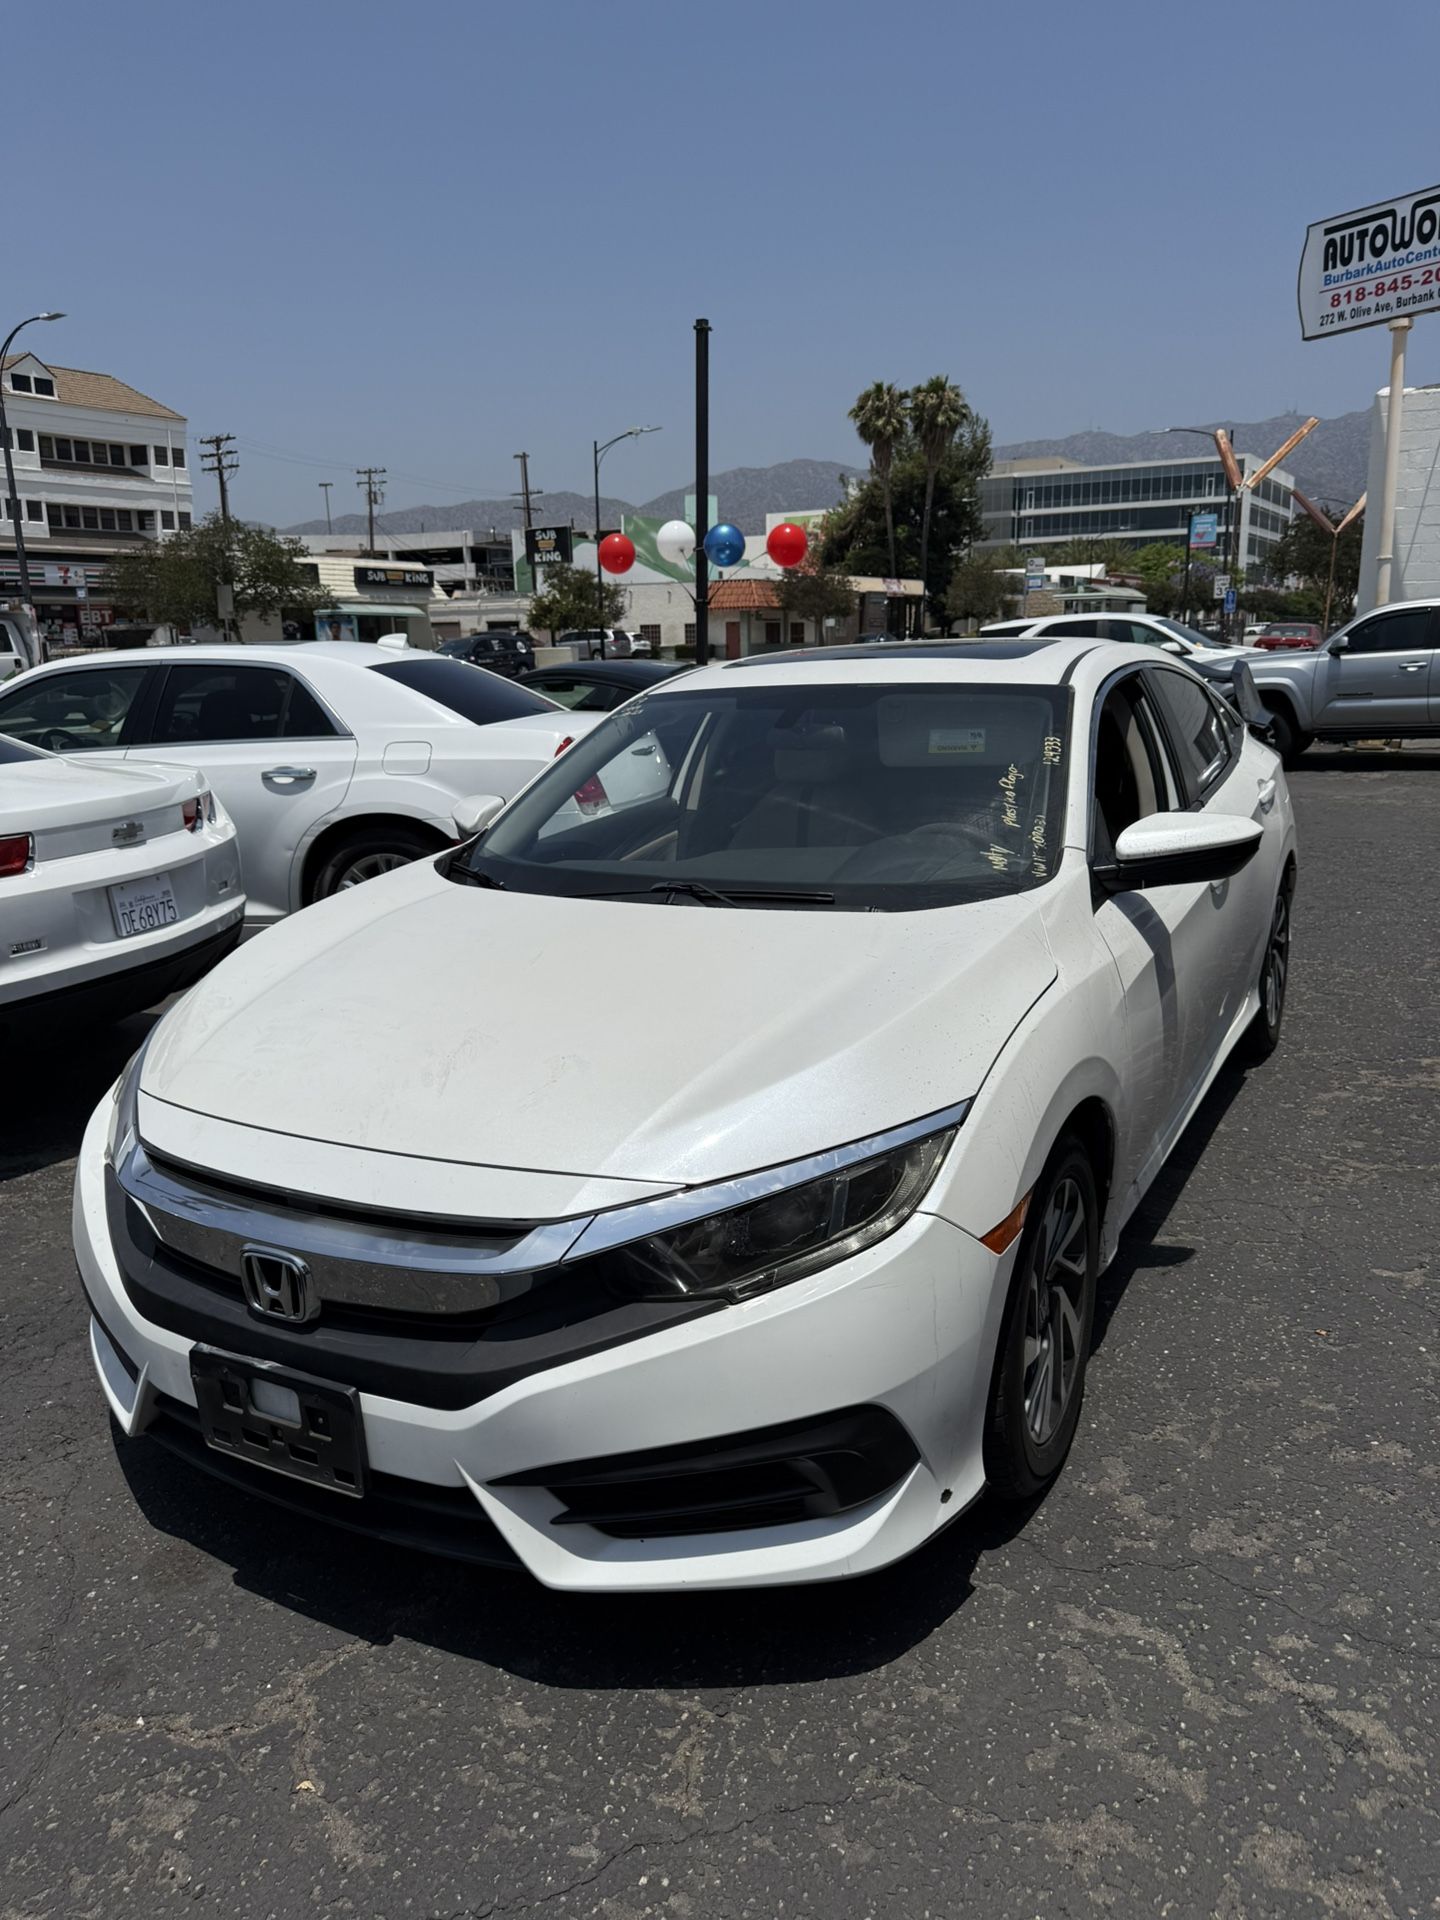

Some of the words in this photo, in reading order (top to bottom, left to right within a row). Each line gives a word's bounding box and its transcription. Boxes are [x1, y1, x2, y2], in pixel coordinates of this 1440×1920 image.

[1323, 194, 1440, 272] AUTOWO
[1323, 246, 1440, 287] BurbarkAutoCent
[1319, 312, 1336, 328] 272
[1337, 310, 1347, 322] W.
[1350, 306, 1372, 320] Olive
[1373, 301, 1394, 314] Ave,
[1396, 289, 1435, 309] Burbank
[535, 530, 557, 540] SUB
[367, 570, 386, 582] SUB
[80, 610, 112, 624] EBT
[121, 898, 177, 934] DE68Y75
